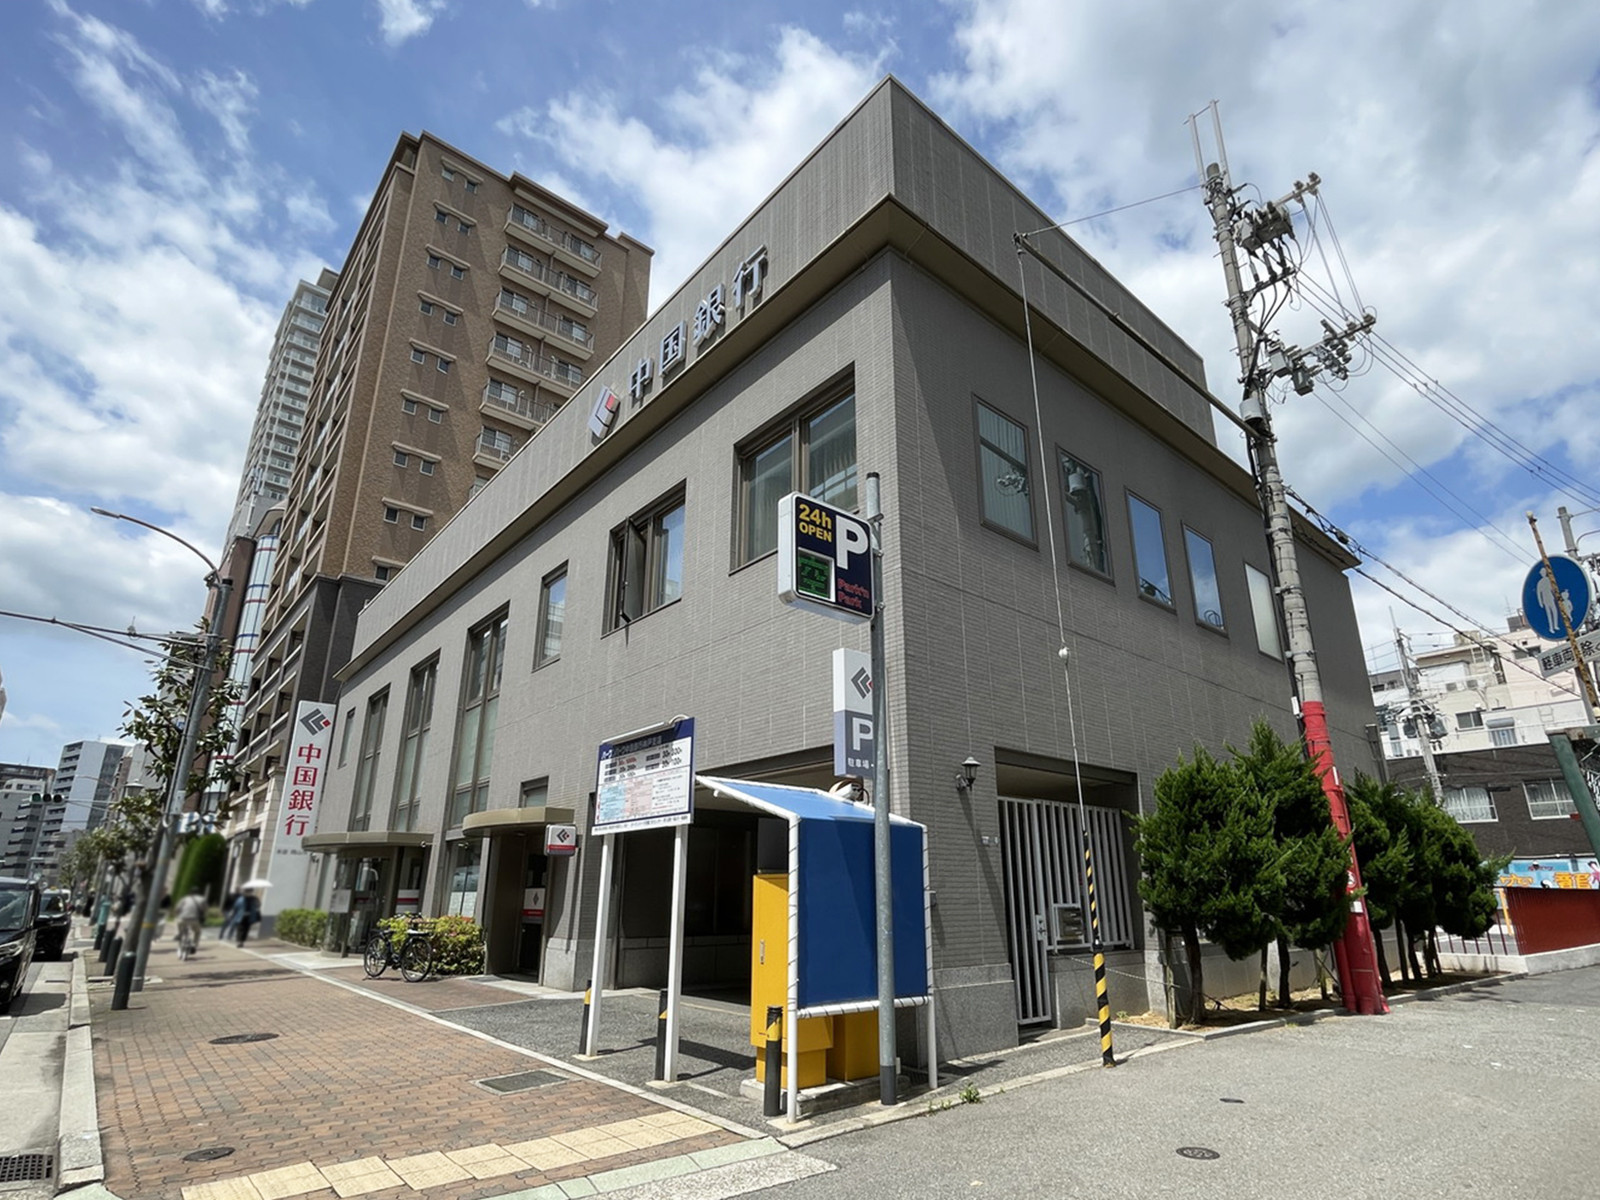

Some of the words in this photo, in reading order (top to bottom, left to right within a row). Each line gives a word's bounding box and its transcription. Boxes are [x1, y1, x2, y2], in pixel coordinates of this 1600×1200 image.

[629, 244, 768, 400] 中国銀行
[799, 504, 832, 530] 24h
[799, 523, 832, 543] OPEN
[836, 514, 869, 570] P
[852, 716, 874, 751] P
[284, 743, 322, 837] 中国銀行
